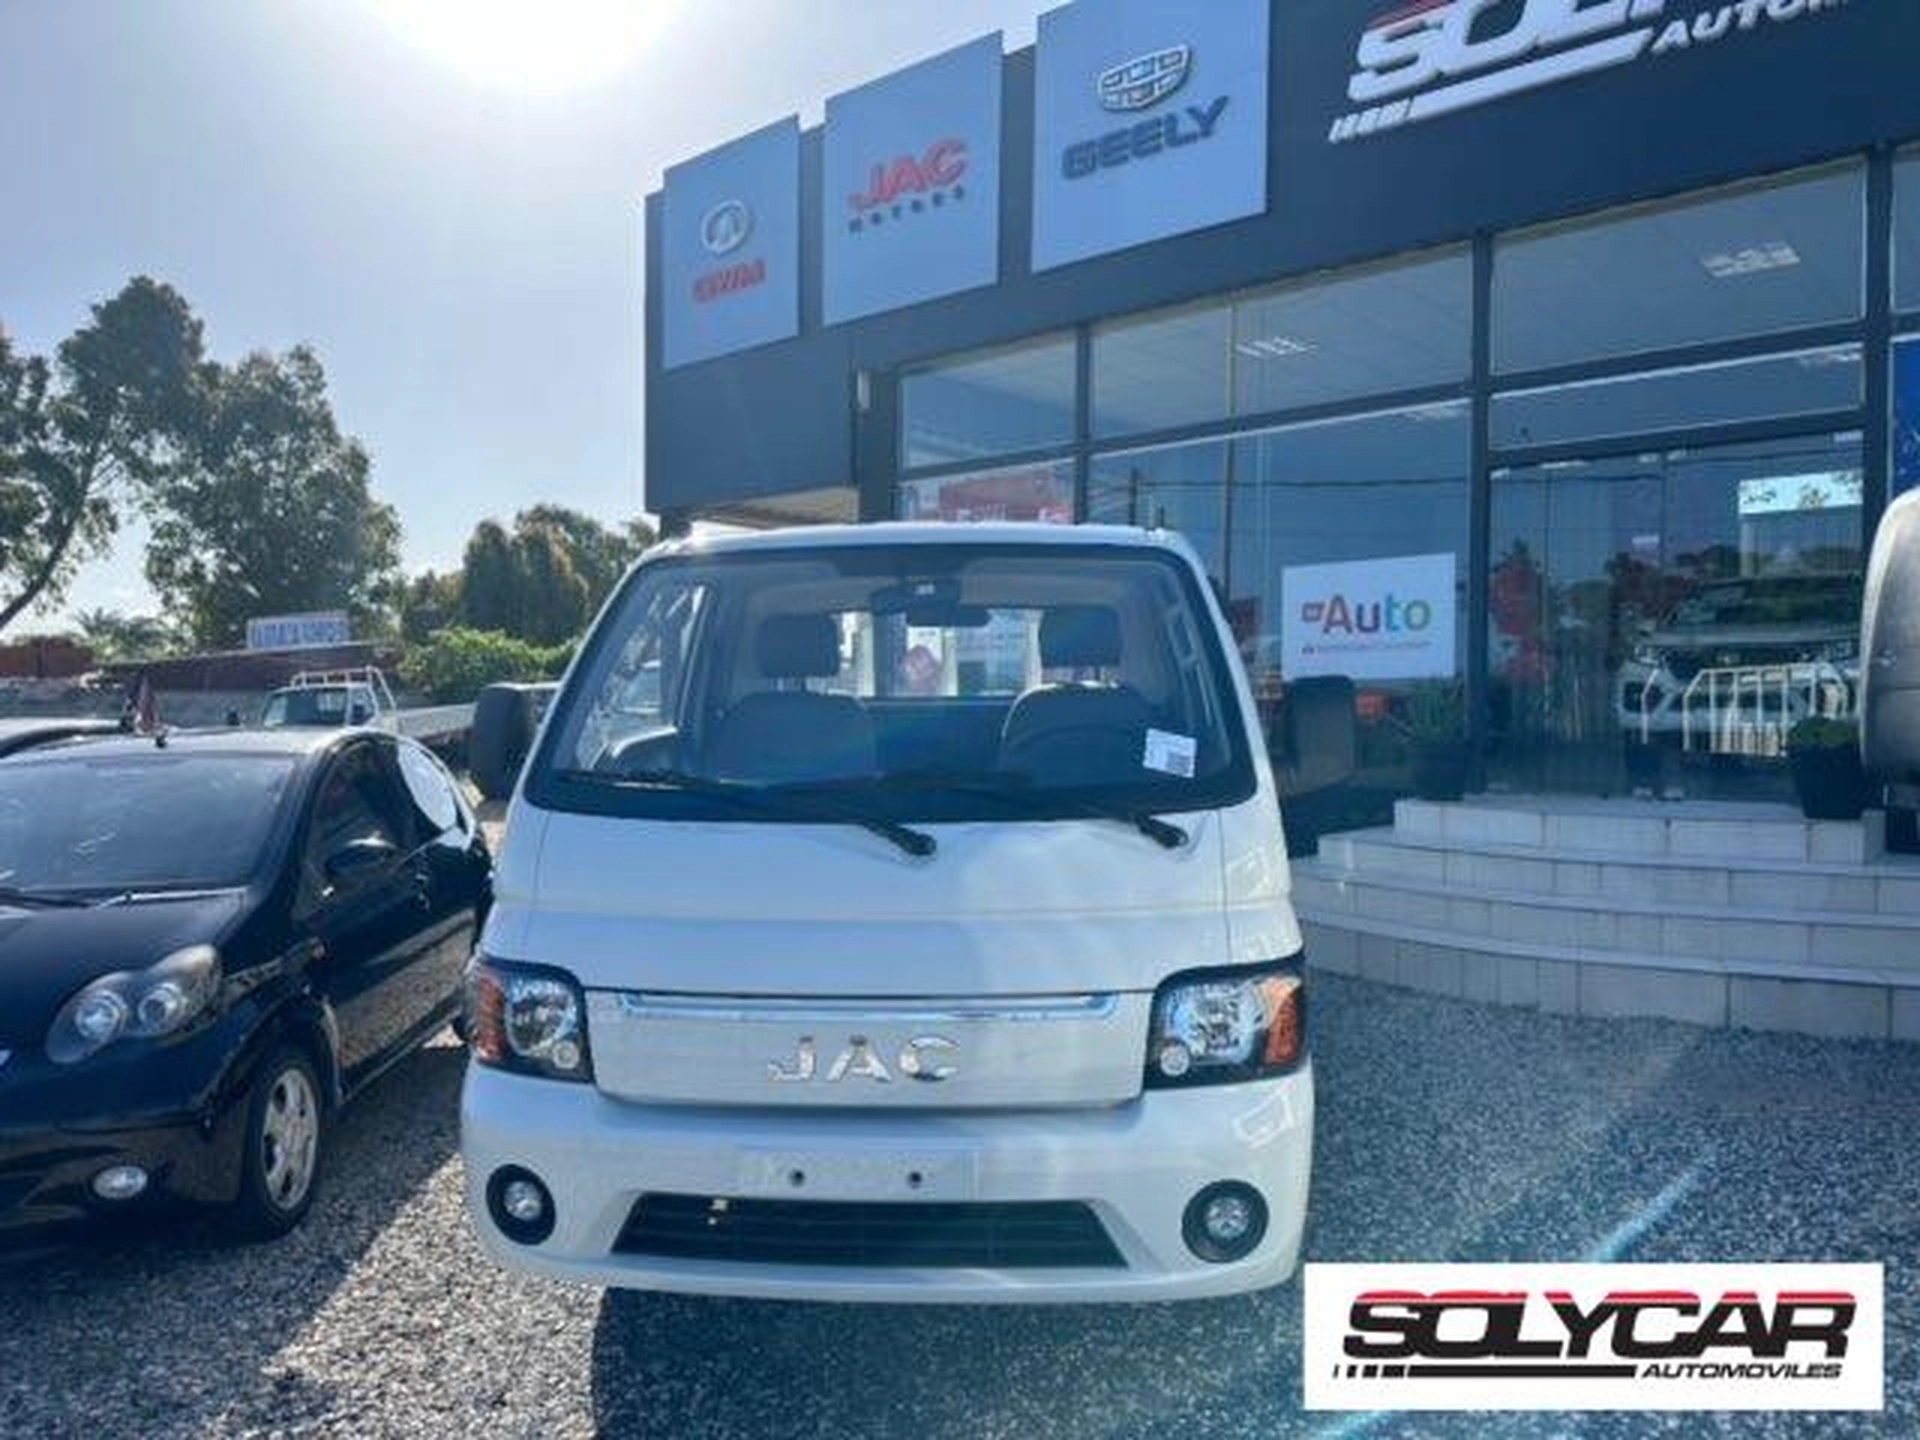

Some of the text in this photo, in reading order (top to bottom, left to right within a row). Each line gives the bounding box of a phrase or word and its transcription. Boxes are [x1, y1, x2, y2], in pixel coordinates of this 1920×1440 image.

[1062, 95, 1229, 180] GEELY
[848, 138, 967, 213] JAC
[1323, 593, 1432, 634] Auto
[768, 1034, 960, 1083] JAC
